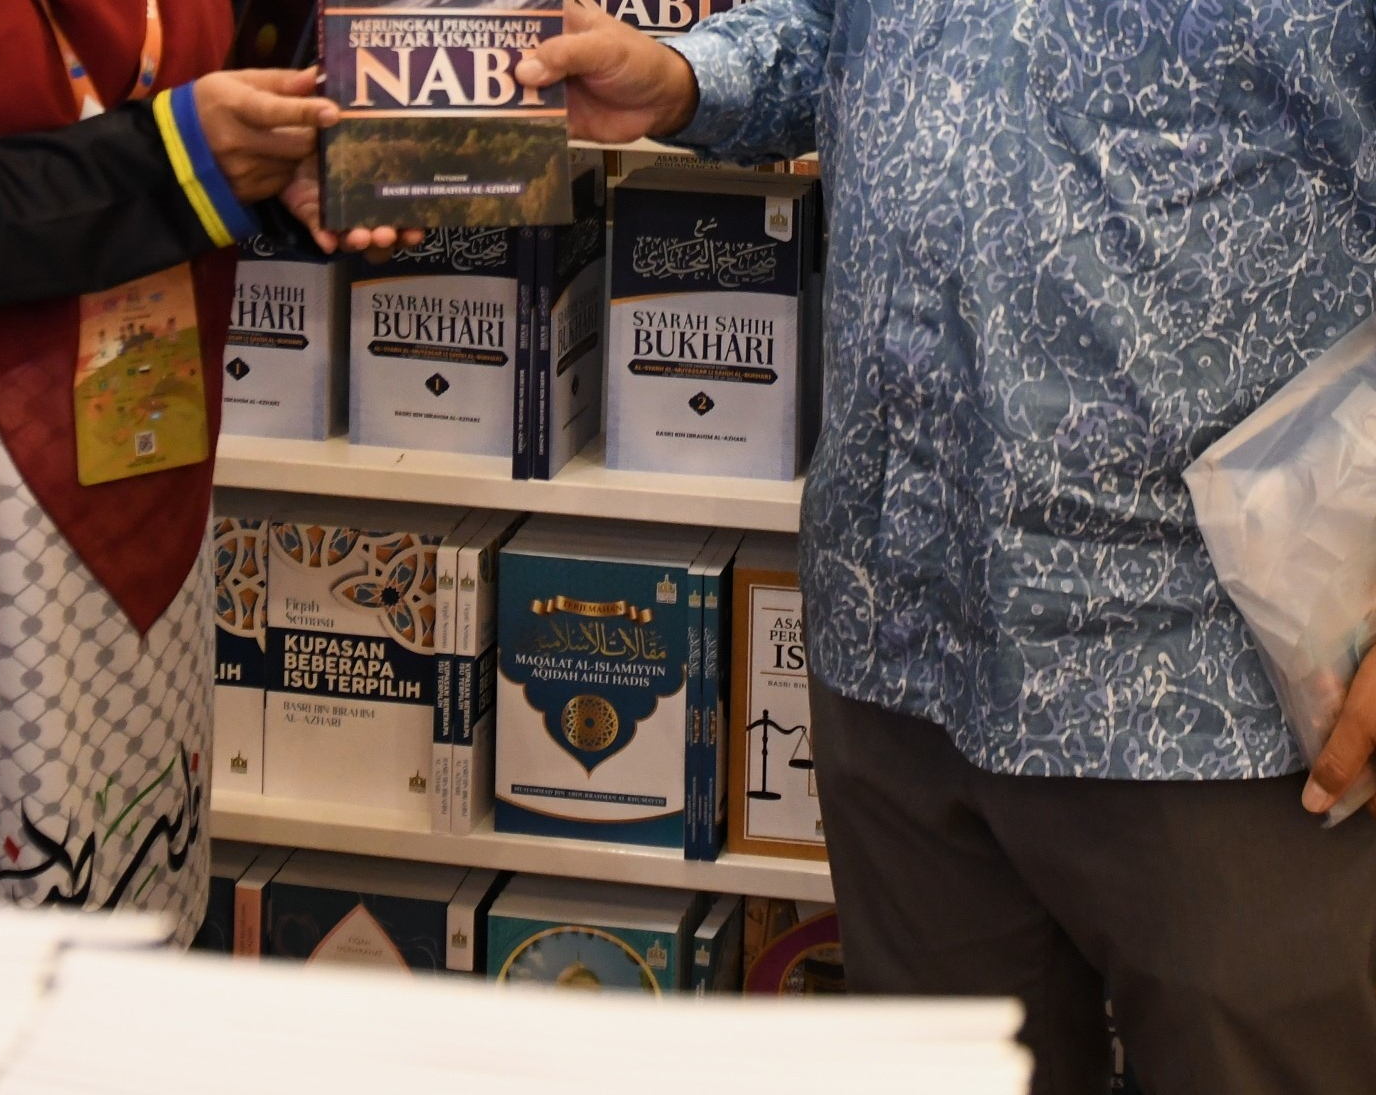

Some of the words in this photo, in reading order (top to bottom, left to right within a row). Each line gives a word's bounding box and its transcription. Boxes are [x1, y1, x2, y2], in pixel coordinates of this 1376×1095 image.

[351, 19, 440, 33] MERUNGKAI
[442, 19, 523, 33] PERSOALAN
[525, 20, 541, 34] DI
[349, 32, 430, 48] SEKITAR
[433, 31, 491, 48] KISAH
[493, 32, 540, 49] PARA
[250, 283, 305, 302] SAHIH
[228, 301, 305, 332] HARI
[372, 293, 442, 314] SYARAH
[449, 299, 504, 319] SAHIH
[373, 310, 505, 347] BUKHARI
[632, 310, 708, 331] SYARAH
[715, 316, 774, 336] SAHIH
[633, 328, 774, 365] BUKHARI
[697, 396, 707, 410] 2
[285, 597, 320, 613] Fiqah
[773, 617, 803, 630] ASA
[284, 633, 385, 660] KUPASAN
[772, 643, 805, 671] IS
[284, 653, 395, 679] BEBERAPA
[515, 654, 573, 670] MAQALAT
[575, 660, 666, 677] AL-ISLAMIYYIN
[531, 667, 578, 682] AQIDAH
[581, 671, 609, 685] AHLI
[612, 675, 650, 688] HADIS
[283, 669, 319, 690] ISU
[324, 673, 421, 699] TERPILIH
[767, 680, 791, 688] BASRI
[793, 682, 807, 690] BIN
